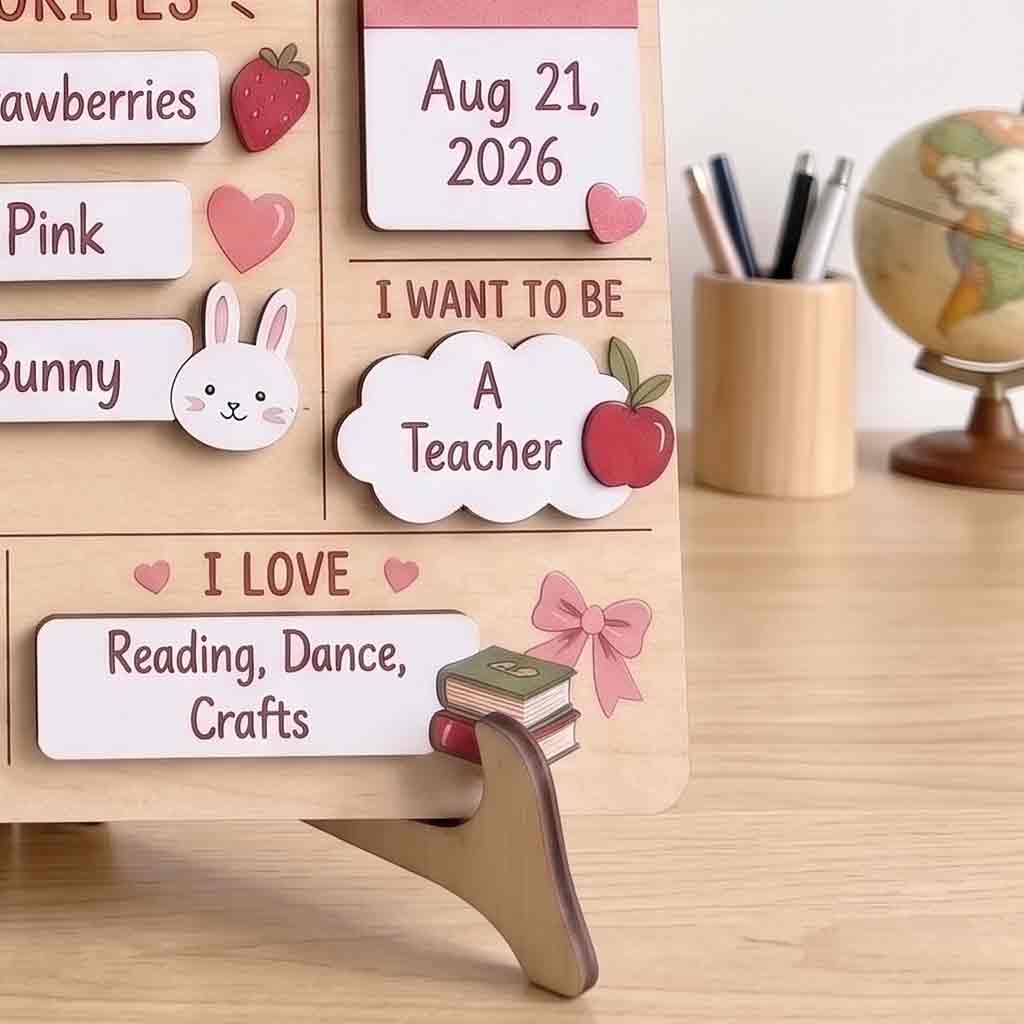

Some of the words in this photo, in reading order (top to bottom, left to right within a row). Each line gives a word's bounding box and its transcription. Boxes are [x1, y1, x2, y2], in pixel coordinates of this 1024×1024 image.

[420, 58, 511, 128] Aug
[534, 59, 600, 118] 21,
[445, 135, 563, 187] 2026
[6, 200, 105, 257] Pink
[375, 279, 392, 320] I
[405, 279, 510, 320] WANT
[521, 279, 567, 319] TO
[580, 278, 625, 319] BE
[472, 360, 503, 411] A
[400, 421, 564, 473] Teacher
[203, 551, 223, 597] I
[242, 550, 351, 597] LOVE
[108, 629, 266, 687] Reading,
[281, 628, 407, 679] Dance,
[190, 694, 310, 741] Crafts
